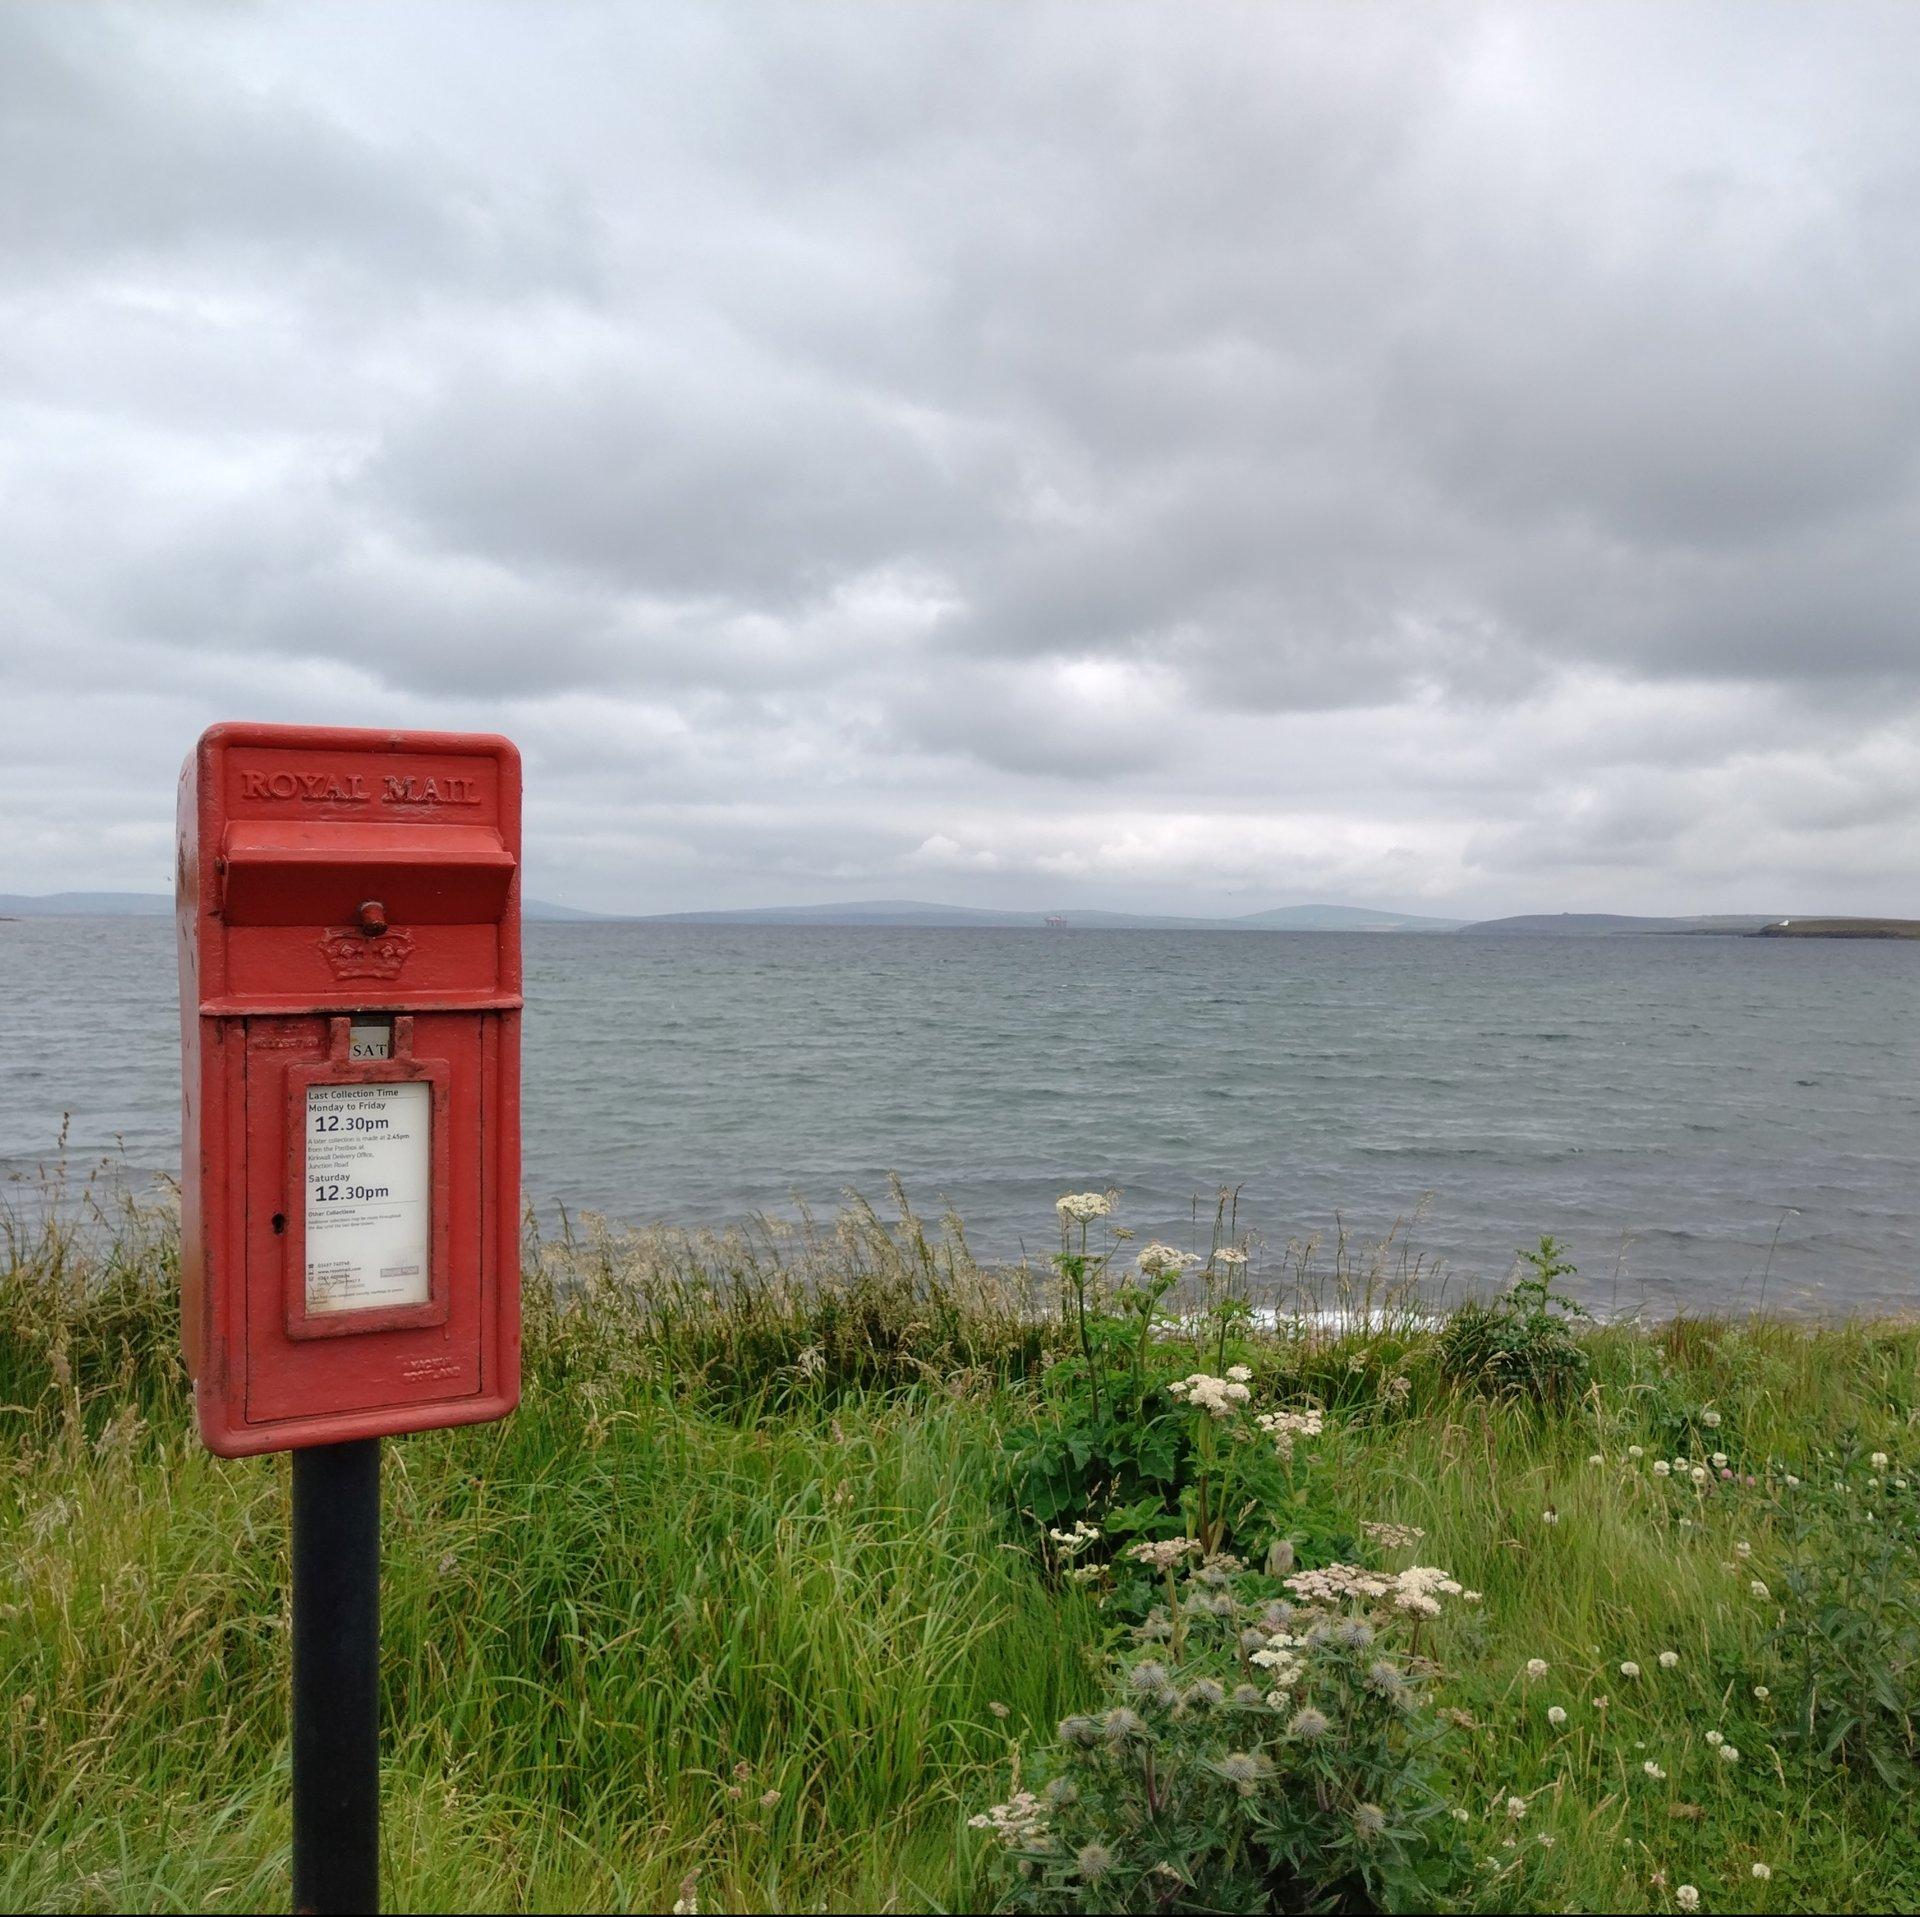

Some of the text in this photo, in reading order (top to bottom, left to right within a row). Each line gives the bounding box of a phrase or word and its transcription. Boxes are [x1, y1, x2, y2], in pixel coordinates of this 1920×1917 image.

[241, 769, 482, 805] ROYAL MAIL
[352, 1044, 388, 1057] SAT
[308, 1088, 399, 1100] Last Collection Time
[308, 1101, 386, 1112] Monday to Friday
[315, 1115, 389, 1132] 12.30pm
[308, 1173, 351, 1183] Saturday
[315, 1185, 389, 1202] 12.30pm
